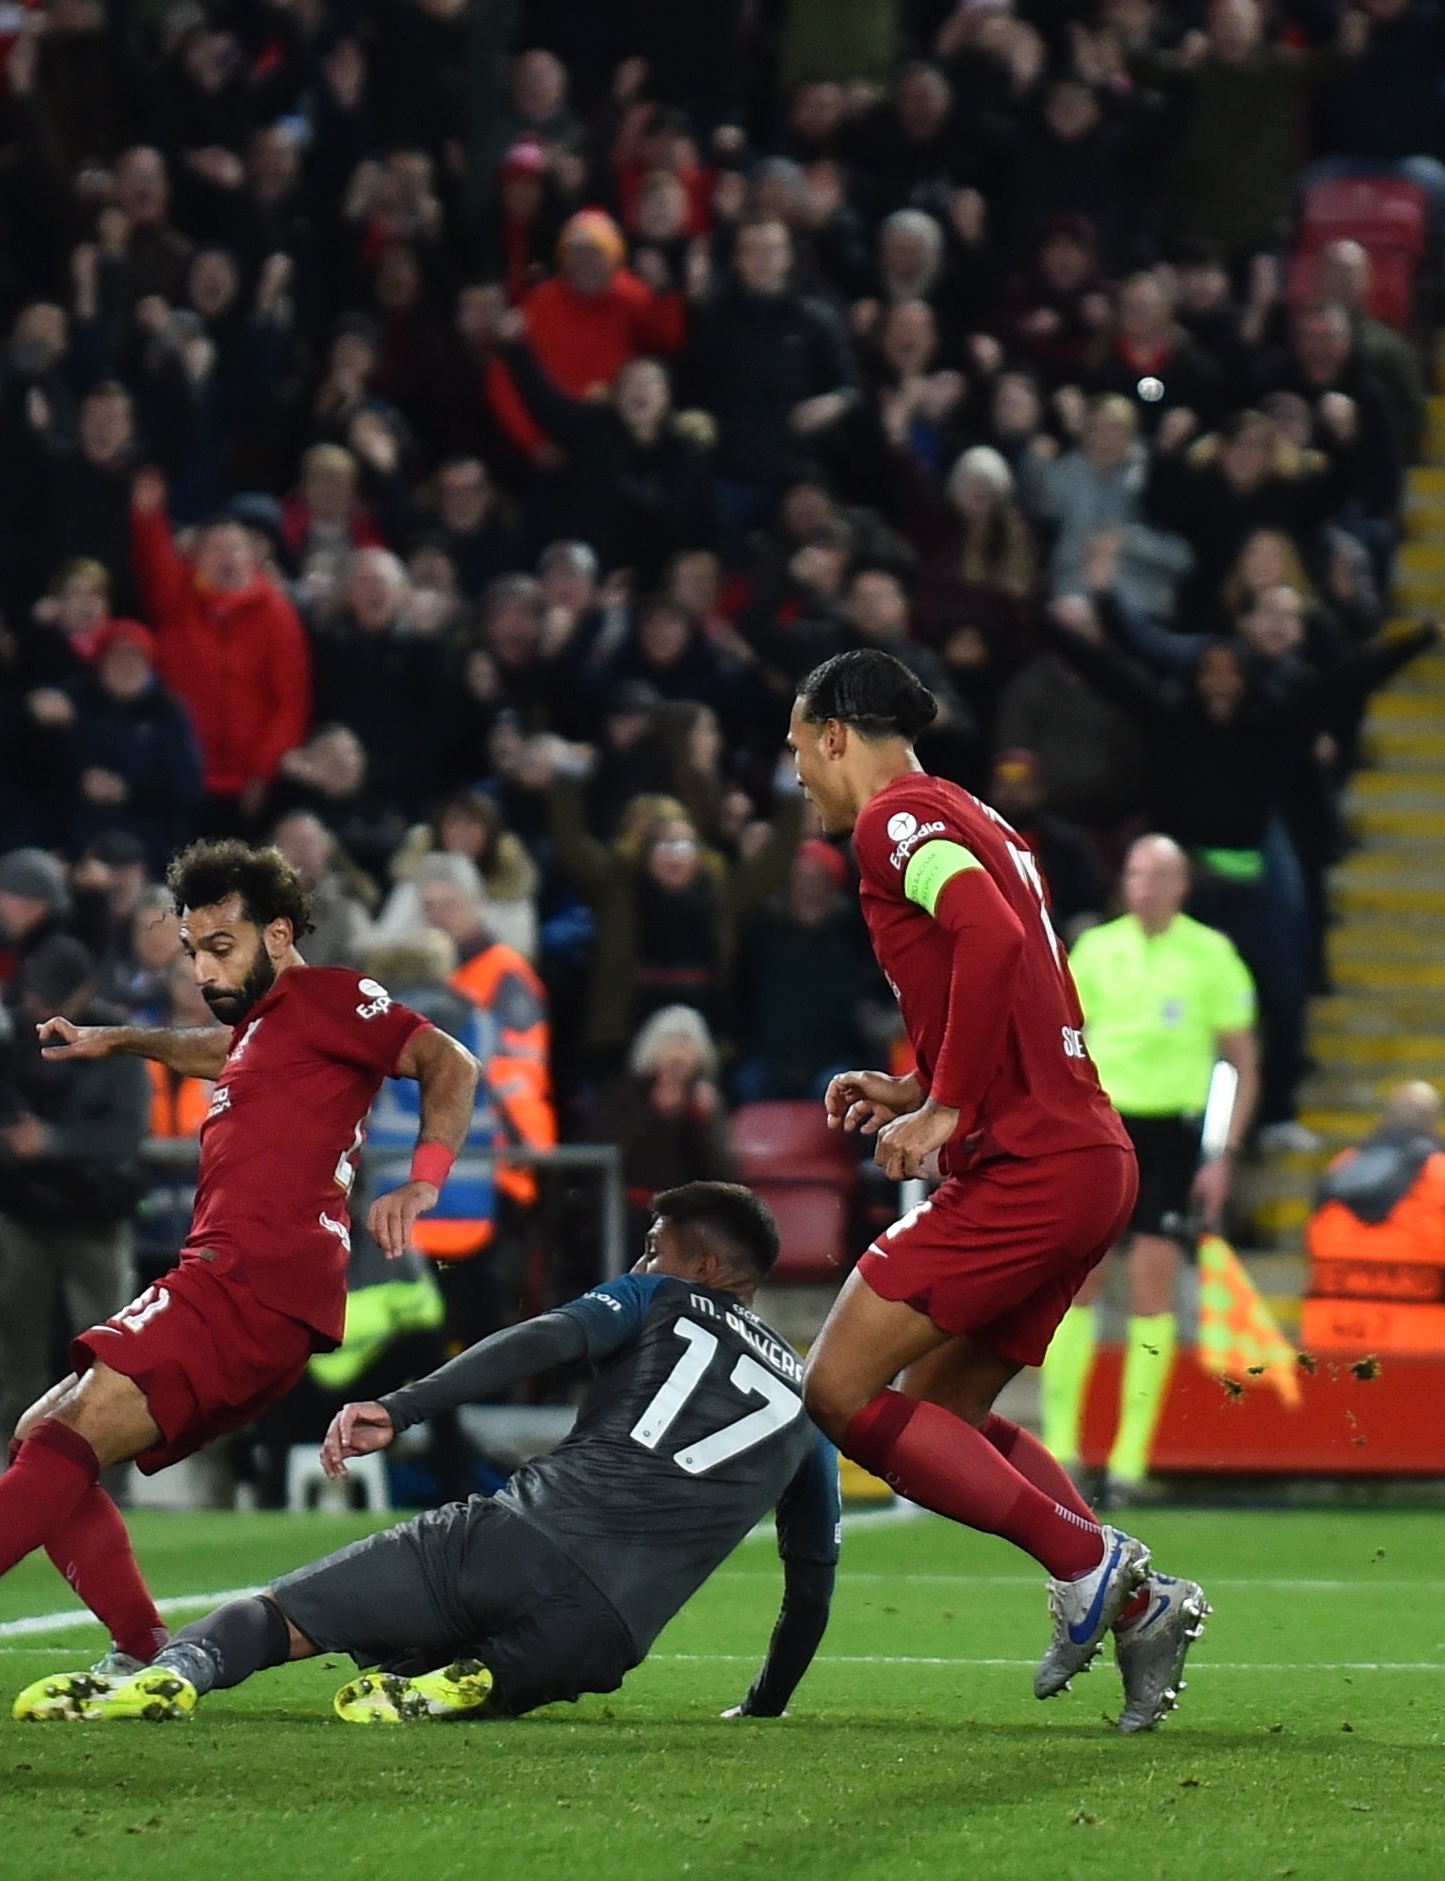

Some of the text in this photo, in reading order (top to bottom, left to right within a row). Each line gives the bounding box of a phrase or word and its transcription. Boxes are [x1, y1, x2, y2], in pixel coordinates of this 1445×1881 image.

[890, 821, 946, 871] Expedia
[355, 996, 393, 1019] Exp
[690, 1293, 722, 1320] M.
[629, 1316, 803, 1474] 17
